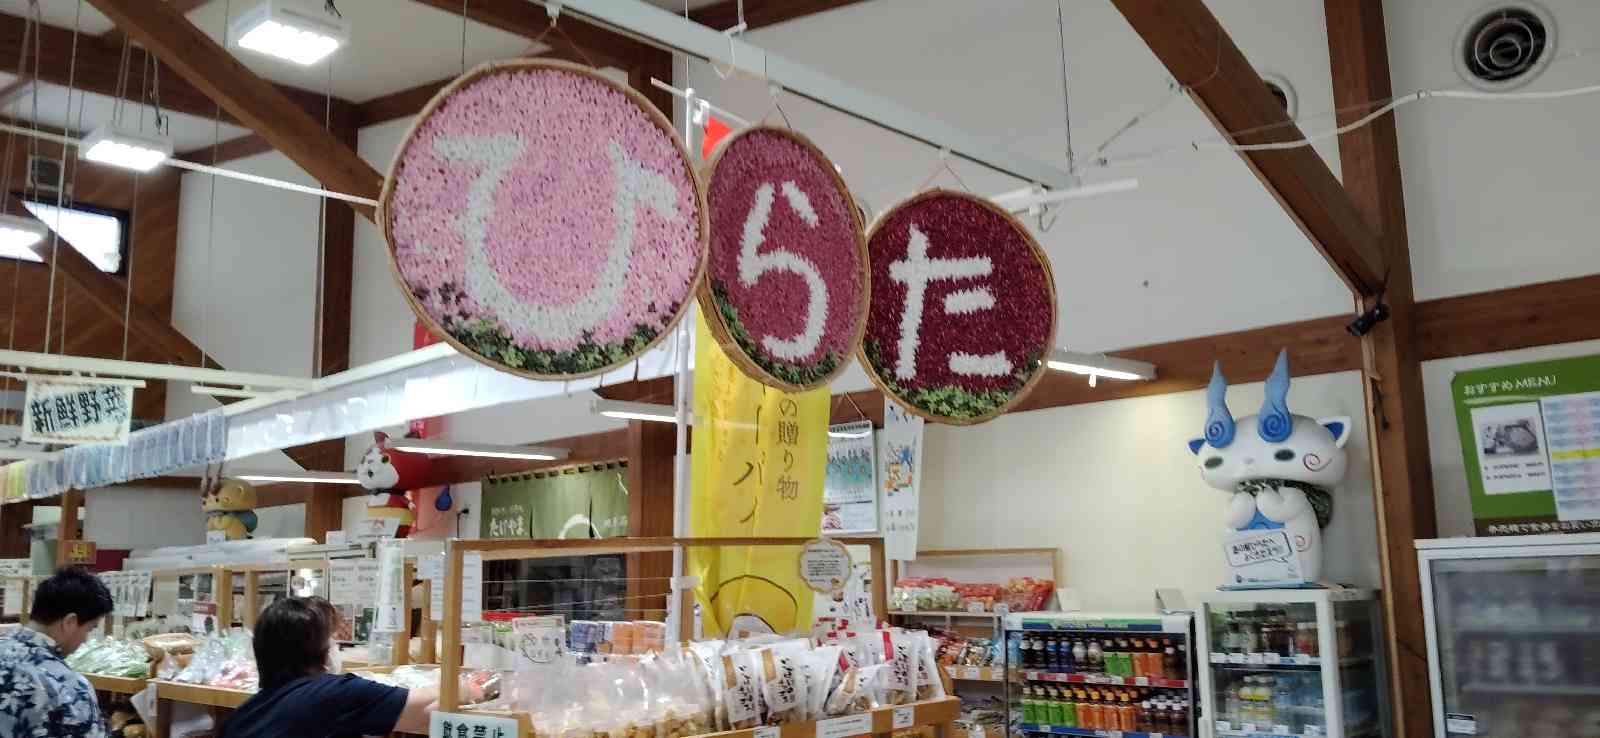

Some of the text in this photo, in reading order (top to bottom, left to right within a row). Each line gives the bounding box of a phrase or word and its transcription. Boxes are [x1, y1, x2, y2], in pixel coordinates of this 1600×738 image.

[433, 134, 1013, 380] ひ ら た
[31, 385, 129, 434] 新鮮野菜
[776, 398, 800, 503] の贈り物
